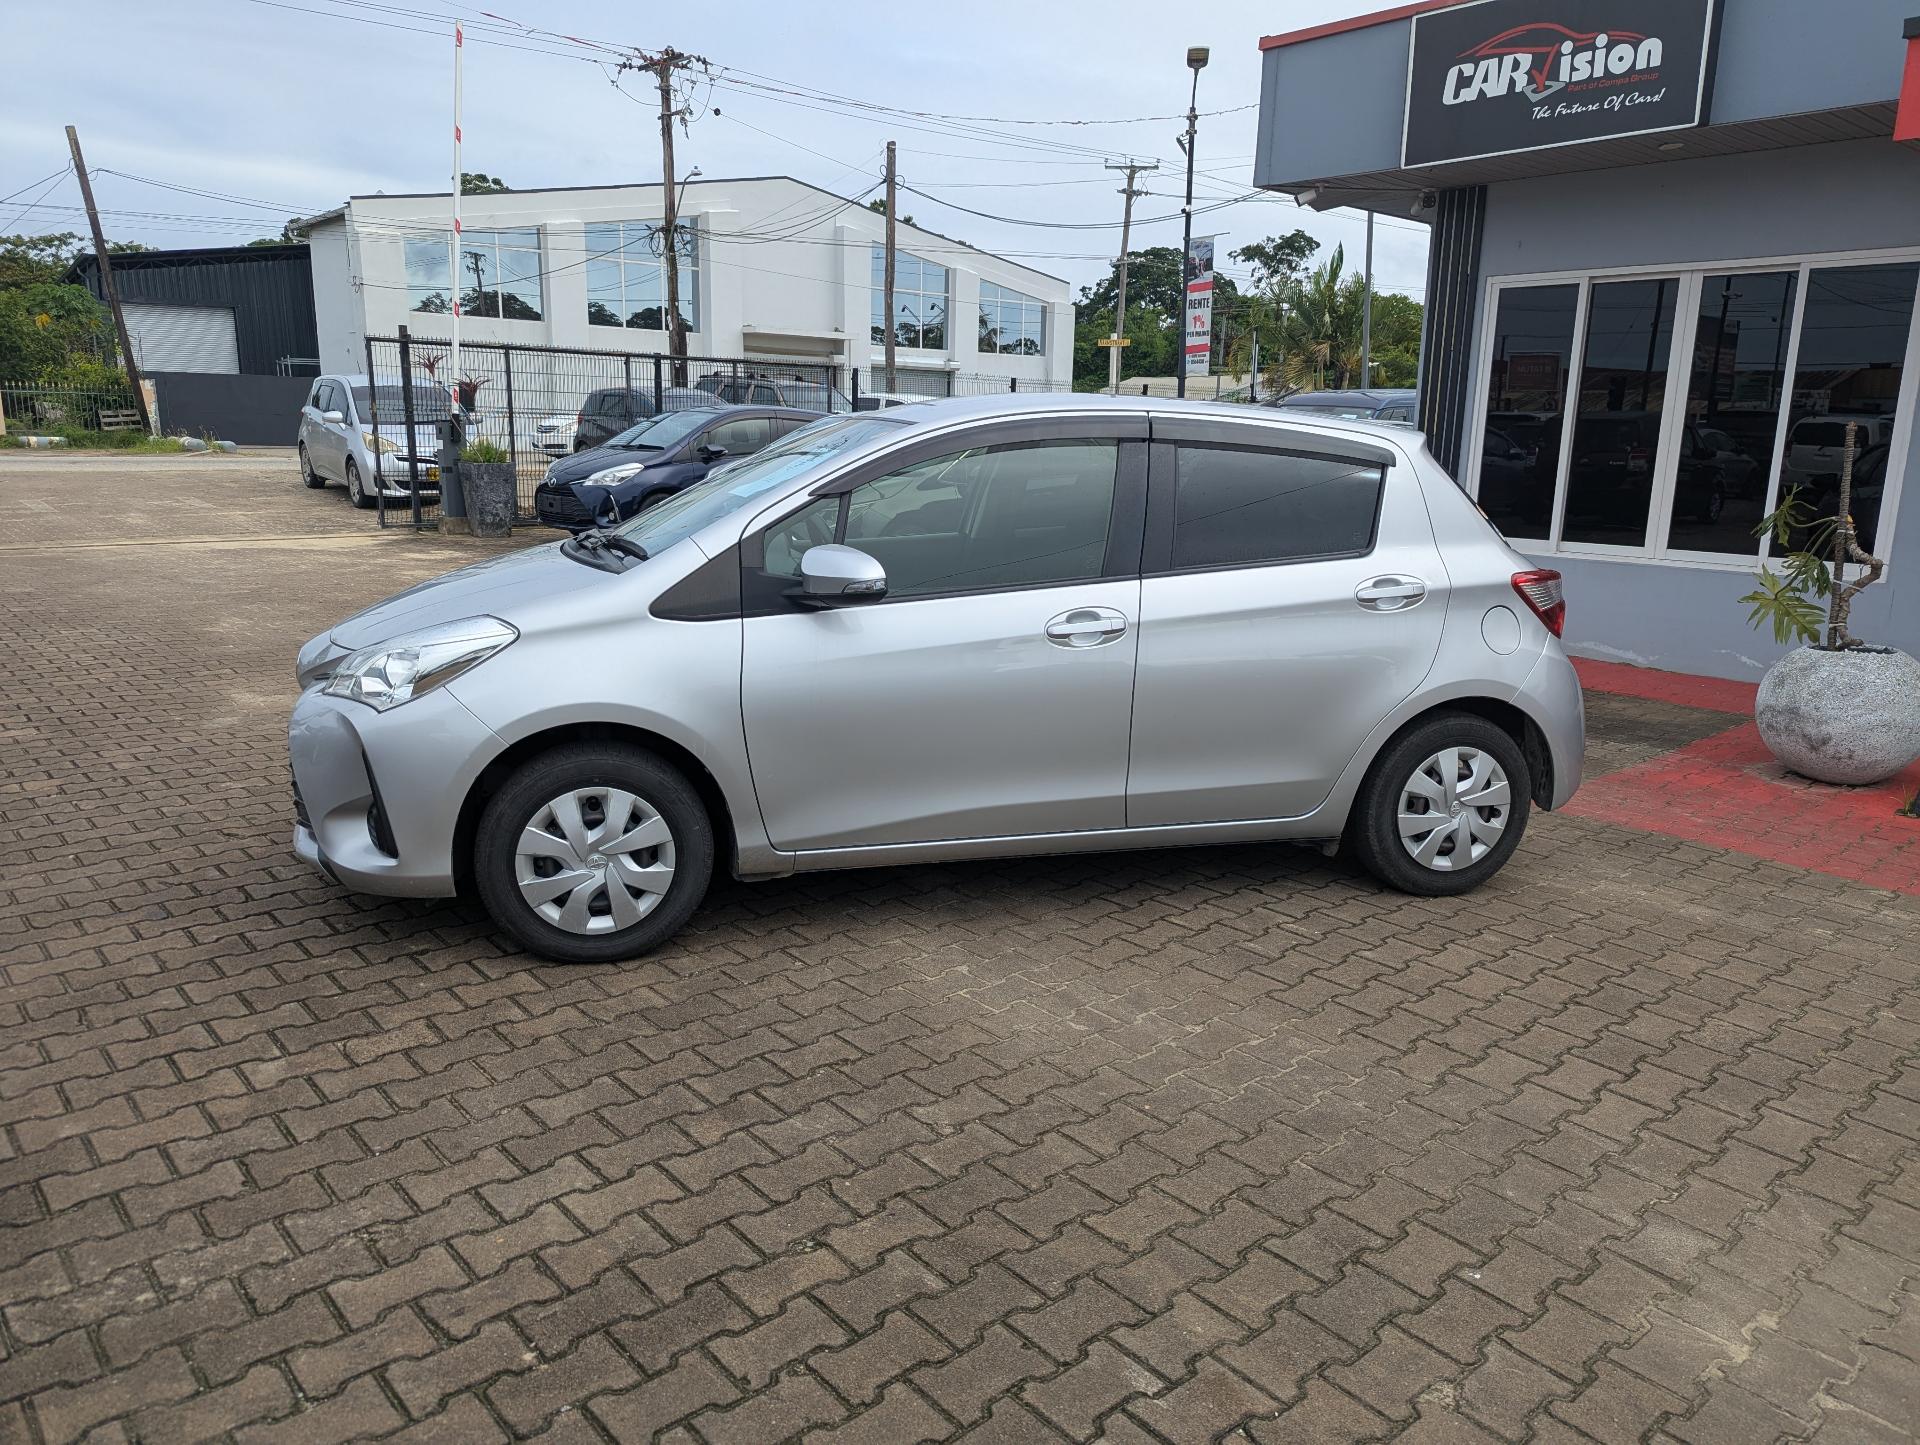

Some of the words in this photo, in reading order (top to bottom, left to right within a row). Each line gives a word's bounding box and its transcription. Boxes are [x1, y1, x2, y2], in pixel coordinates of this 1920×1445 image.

[1567, 83, 1587, 93] Part
[1588, 81, 1598, 90] of
[1630, 72, 1660, 83] Group
[1531, 106, 1552, 120] The
[1554, 101, 1600, 116] Future
[1603, 93, 1622, 112] Of
[1624, 87, 1666, 106] Cars!
[1188, 297, 1210, 310] RENTE
[1192, 314, 1205, 329] 1%
